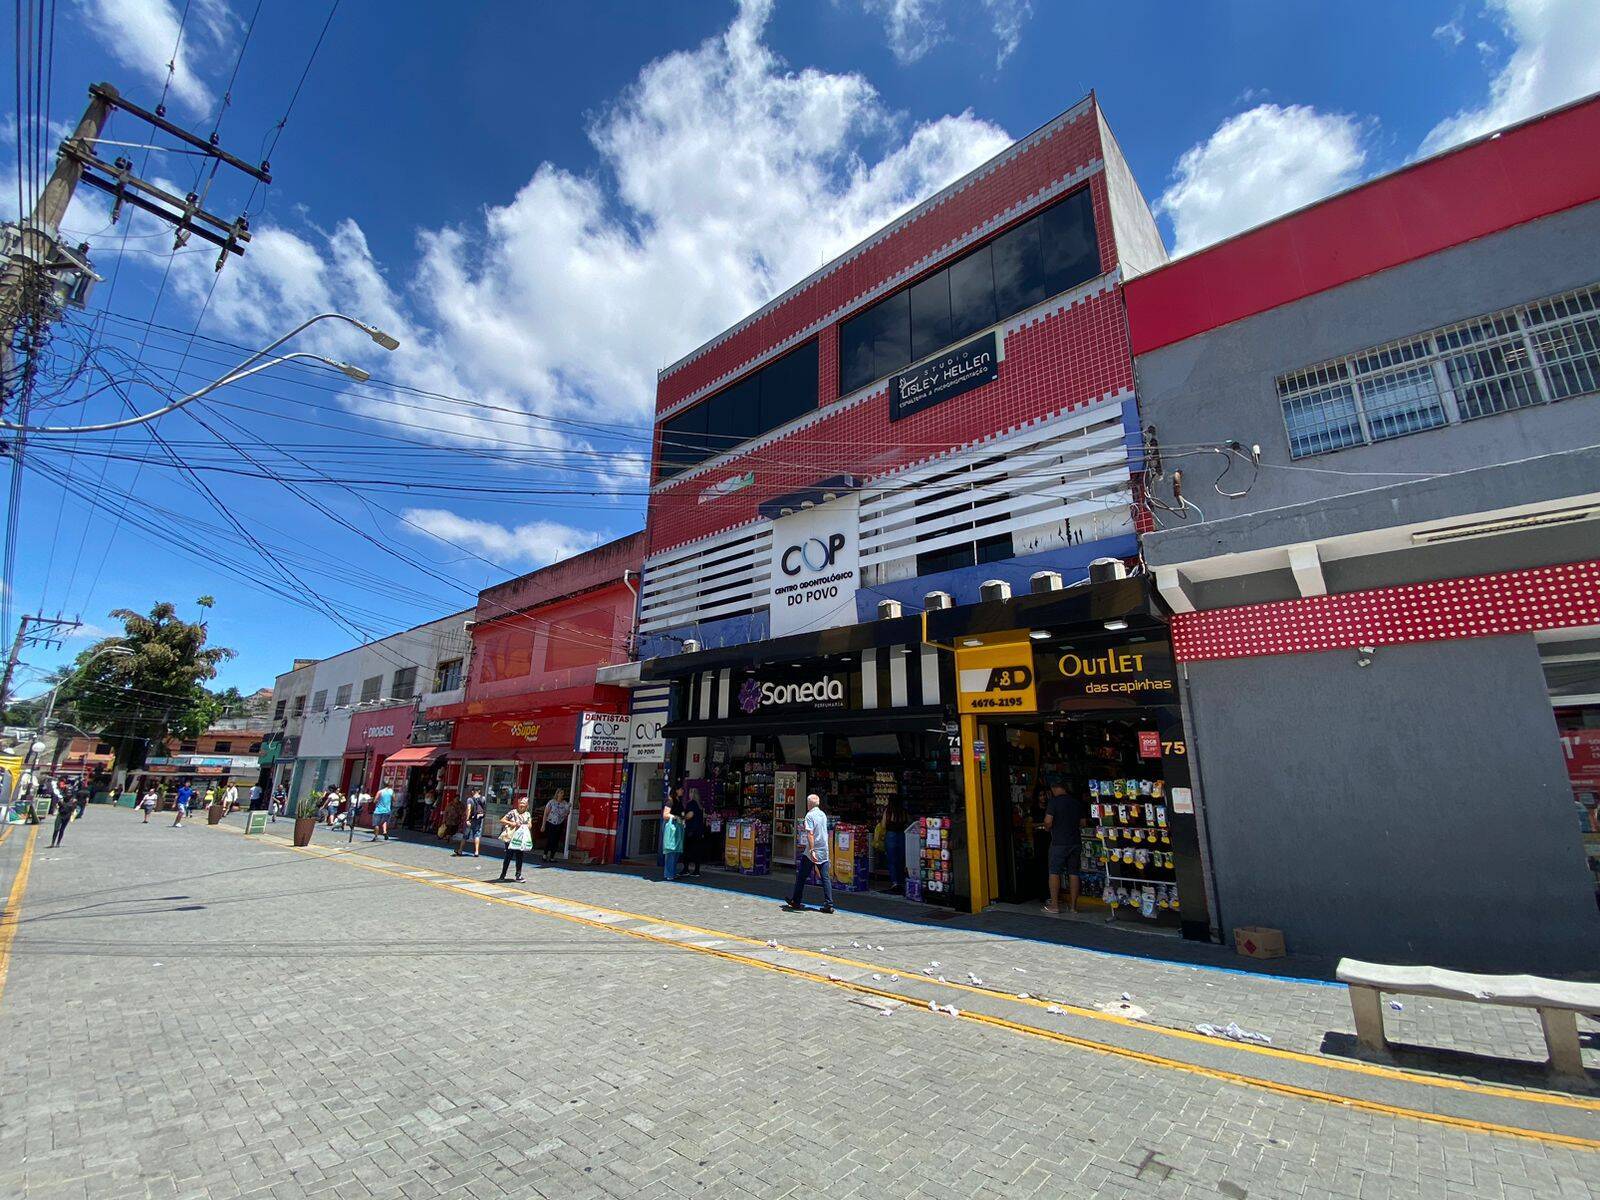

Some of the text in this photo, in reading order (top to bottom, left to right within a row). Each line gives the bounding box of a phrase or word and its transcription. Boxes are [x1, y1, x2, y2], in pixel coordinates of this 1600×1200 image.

[924, 352, 968, 376] STUDIO
[900, 352, 990, 399] LISLEY HELLEN
[781, 533, 846, 576] COP
[774, 571, 854, 595] CENTRO ODONTOLÓGICO
[787, 585, 838, 607] DO POVO
[986, 665, 1032, 692] A&D
[1085, 678, 1172, 694] das capinhas
[761, 675, 844, 705] Soneda
[971, 697, 1023, 708] 4676-2195
[585, 713, 630, 723] DENTISTAS
[593, 722, 620, 737] COP
[636, 720, 662, 741] COP
[947, 736, 960, 747] 71
[1161, 741, 1186, 755] 75
